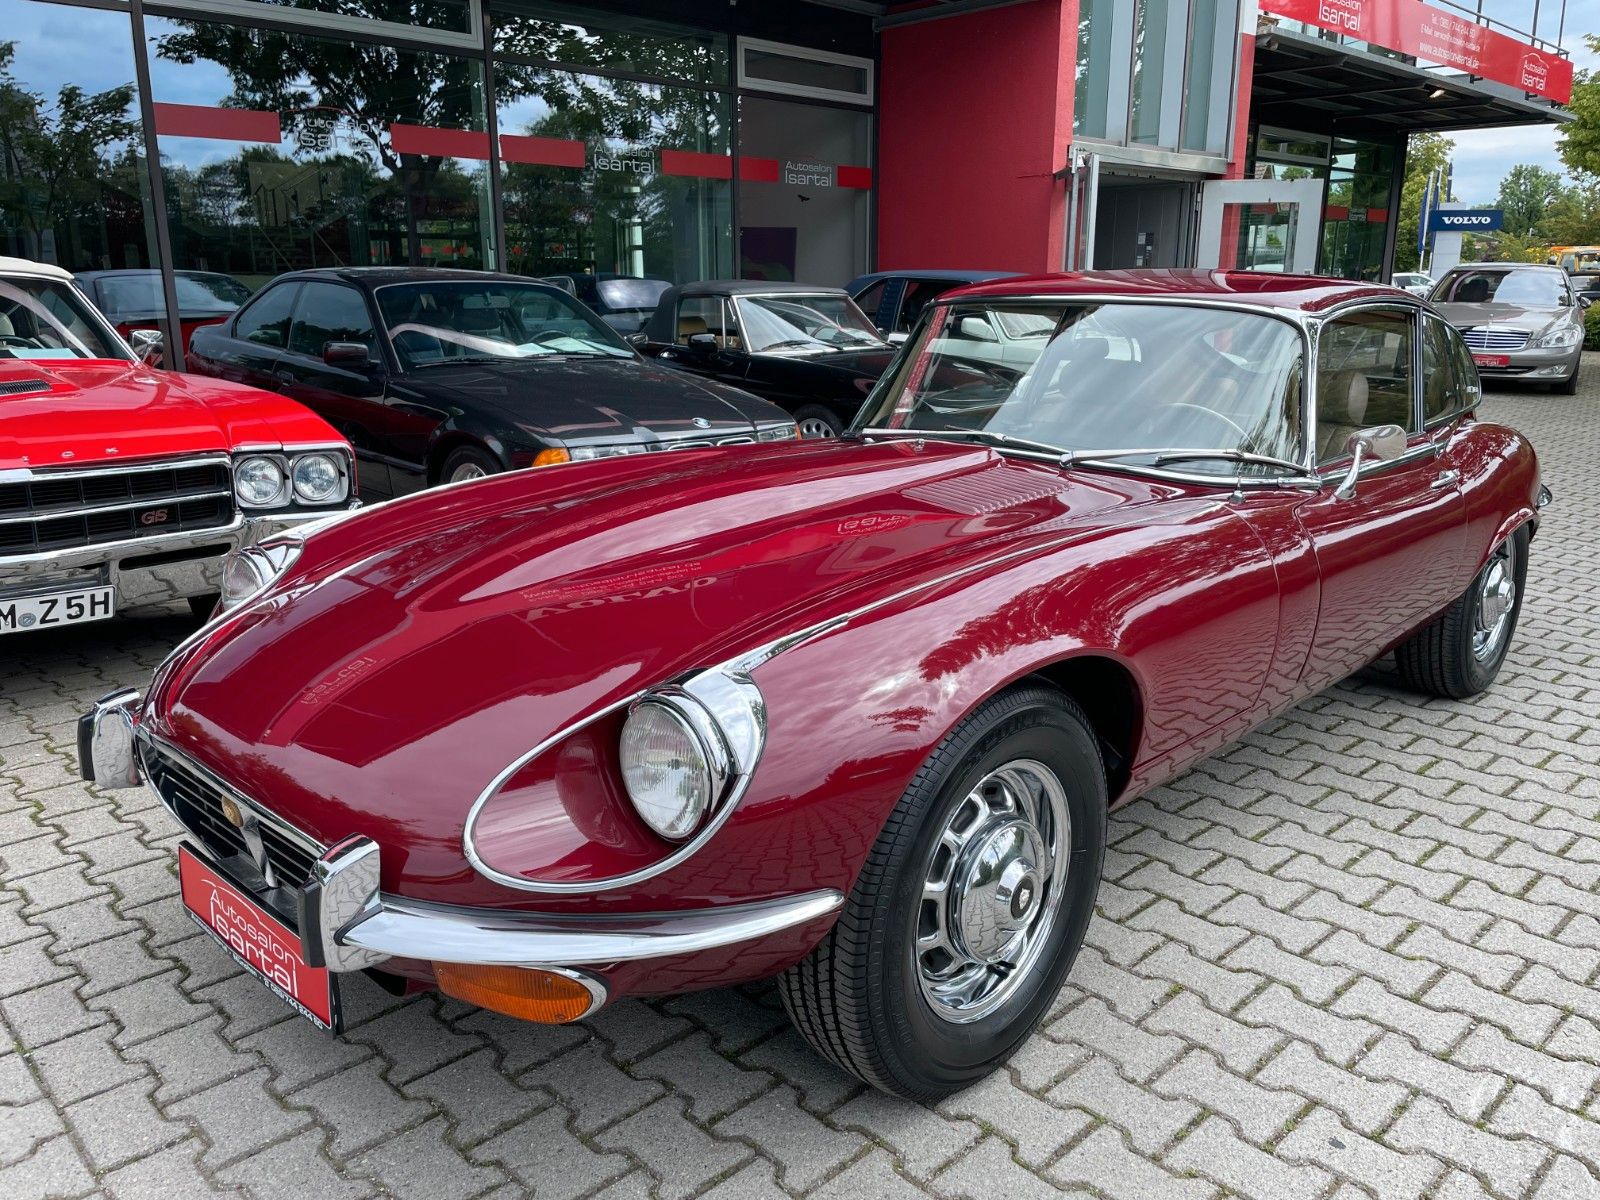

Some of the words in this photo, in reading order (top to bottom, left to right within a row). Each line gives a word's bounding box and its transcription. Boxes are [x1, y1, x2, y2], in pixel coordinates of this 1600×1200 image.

[1318, 0, 1361, 32] Isartal
[1523, 60, 1547, 75] Autosalon
[1521, 69, 1547, 91] Isartal
[294, 116, 380, 133] Autosalon
[594, 144, 655, 158] Autosalon
[593, 154, 656, 174] Isartal
[785, 160, 833, 173] Autosalon
[785, 169, 832, 187] Isartal
[1442, 216, 1491, 225] VOLVO
[141, 508, 168, 525] GS
[0, 603, 17, 630] M
[38, 591, 111, 625] Z5H
[210, 888, 296, 970] Autosalon
[210, 901, 299, 999] Isartal
